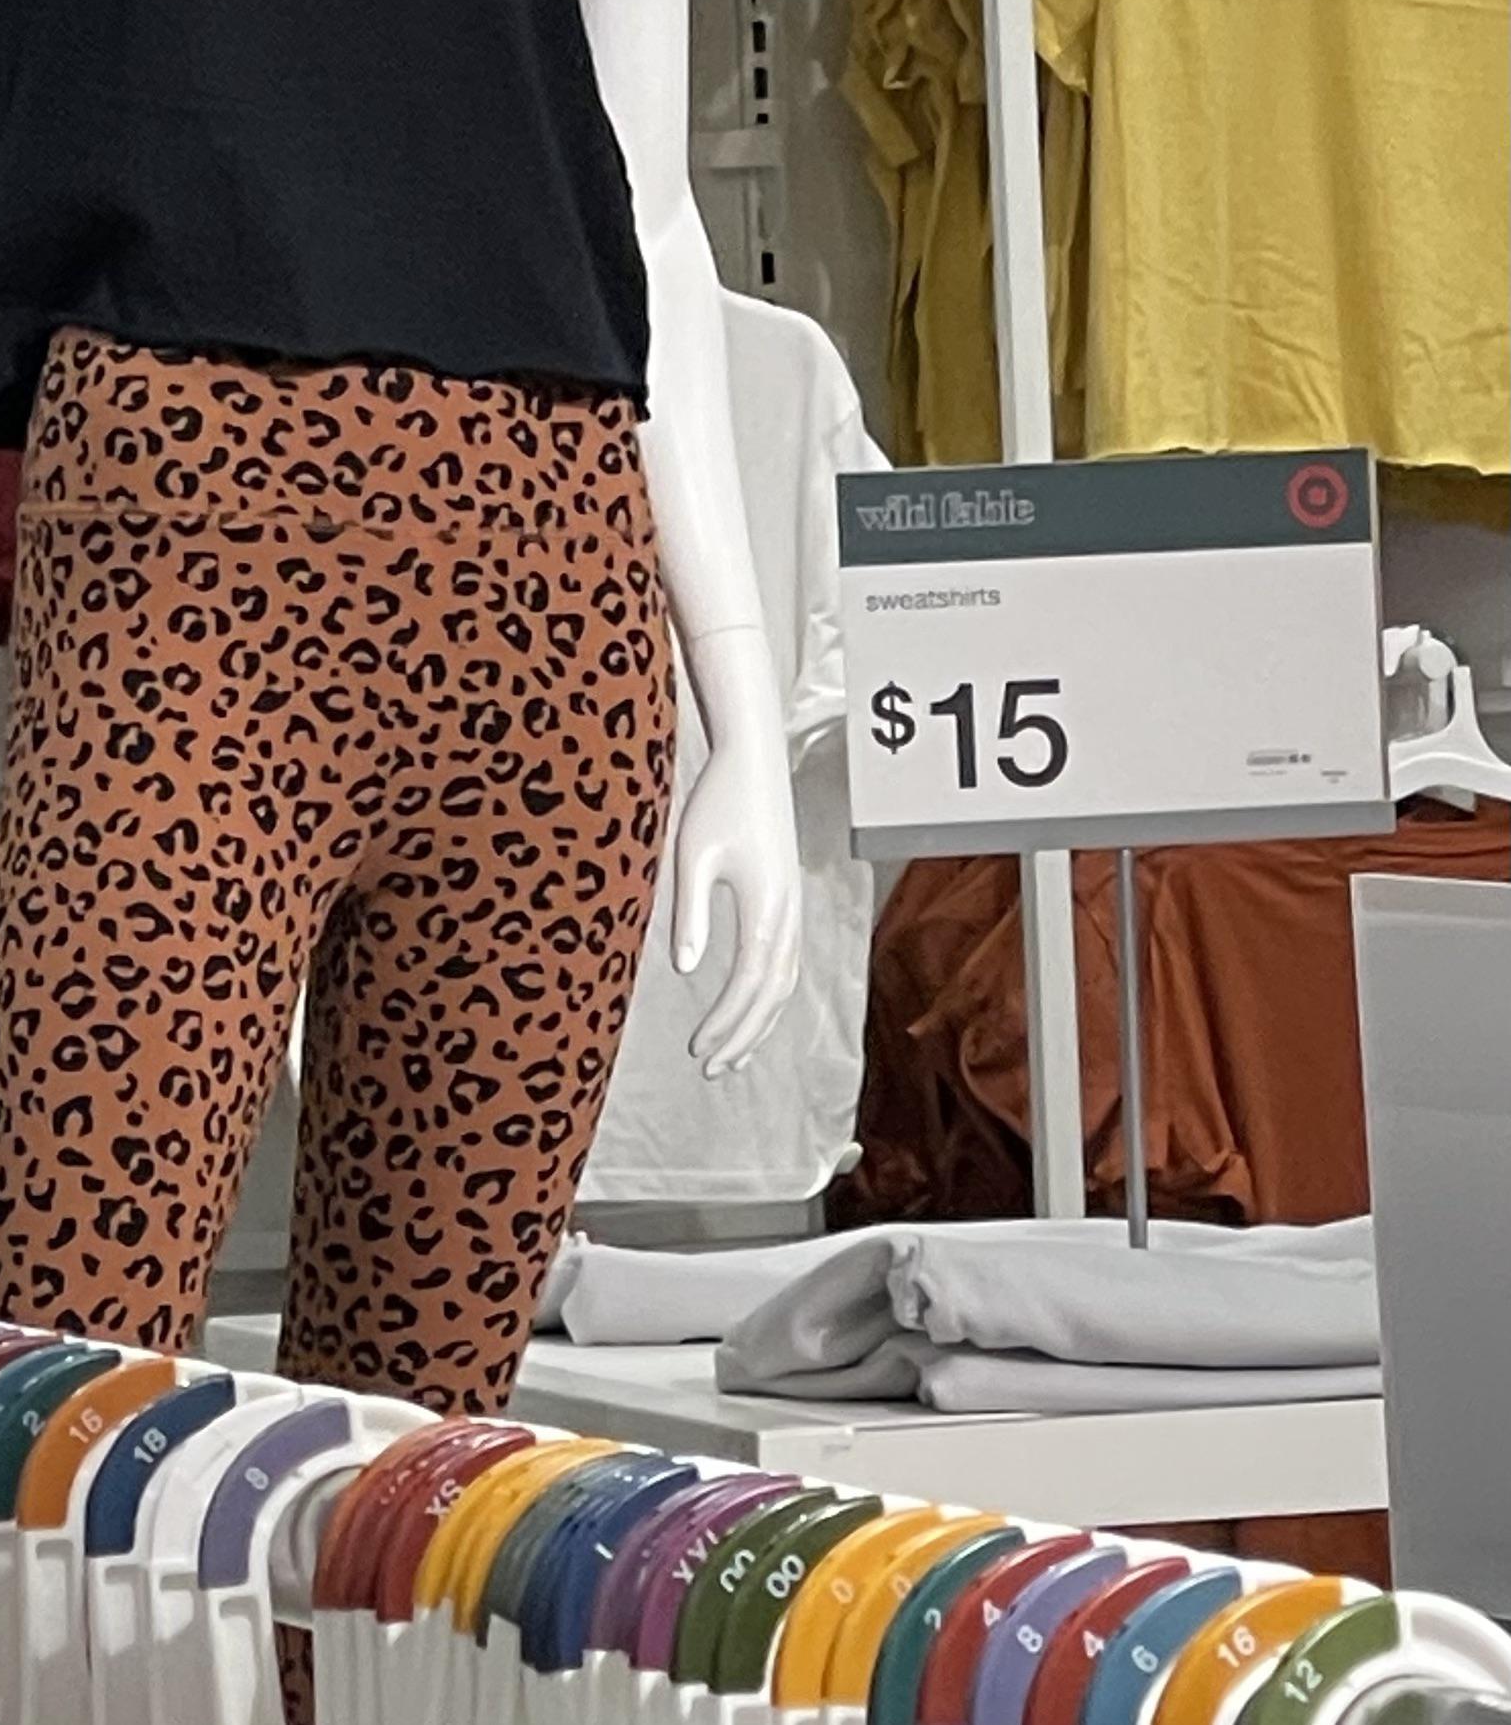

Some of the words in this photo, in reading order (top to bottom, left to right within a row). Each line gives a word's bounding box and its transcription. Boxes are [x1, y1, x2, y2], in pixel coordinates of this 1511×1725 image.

[855, 493, 936, 531] wild
[941, 489, 1036, 529] fable
[865, 588, 1001, 613] sweatshirts
[871, 678, 1068, 789] $15
[22, 1410, 46, 1437] 2
[69, 1407, 104, 1444] 16
[134, 1427, 168, 1464] 18
[244, 1467, 269, 1491] 8
[424, 1478, 465, 1518] XS
[766, 1554, 805, 1598] 00
[831, 1578, 855, 1604] 0
[1017, 1625, 1043, 1653] 8
[1082, 1630, 1105, 1658] 4
[1217, 1625, 1256, 1668] 16
[1131, 1645, 1159, 1673] 6
[1284, 1659, 1323, 1703] 12
